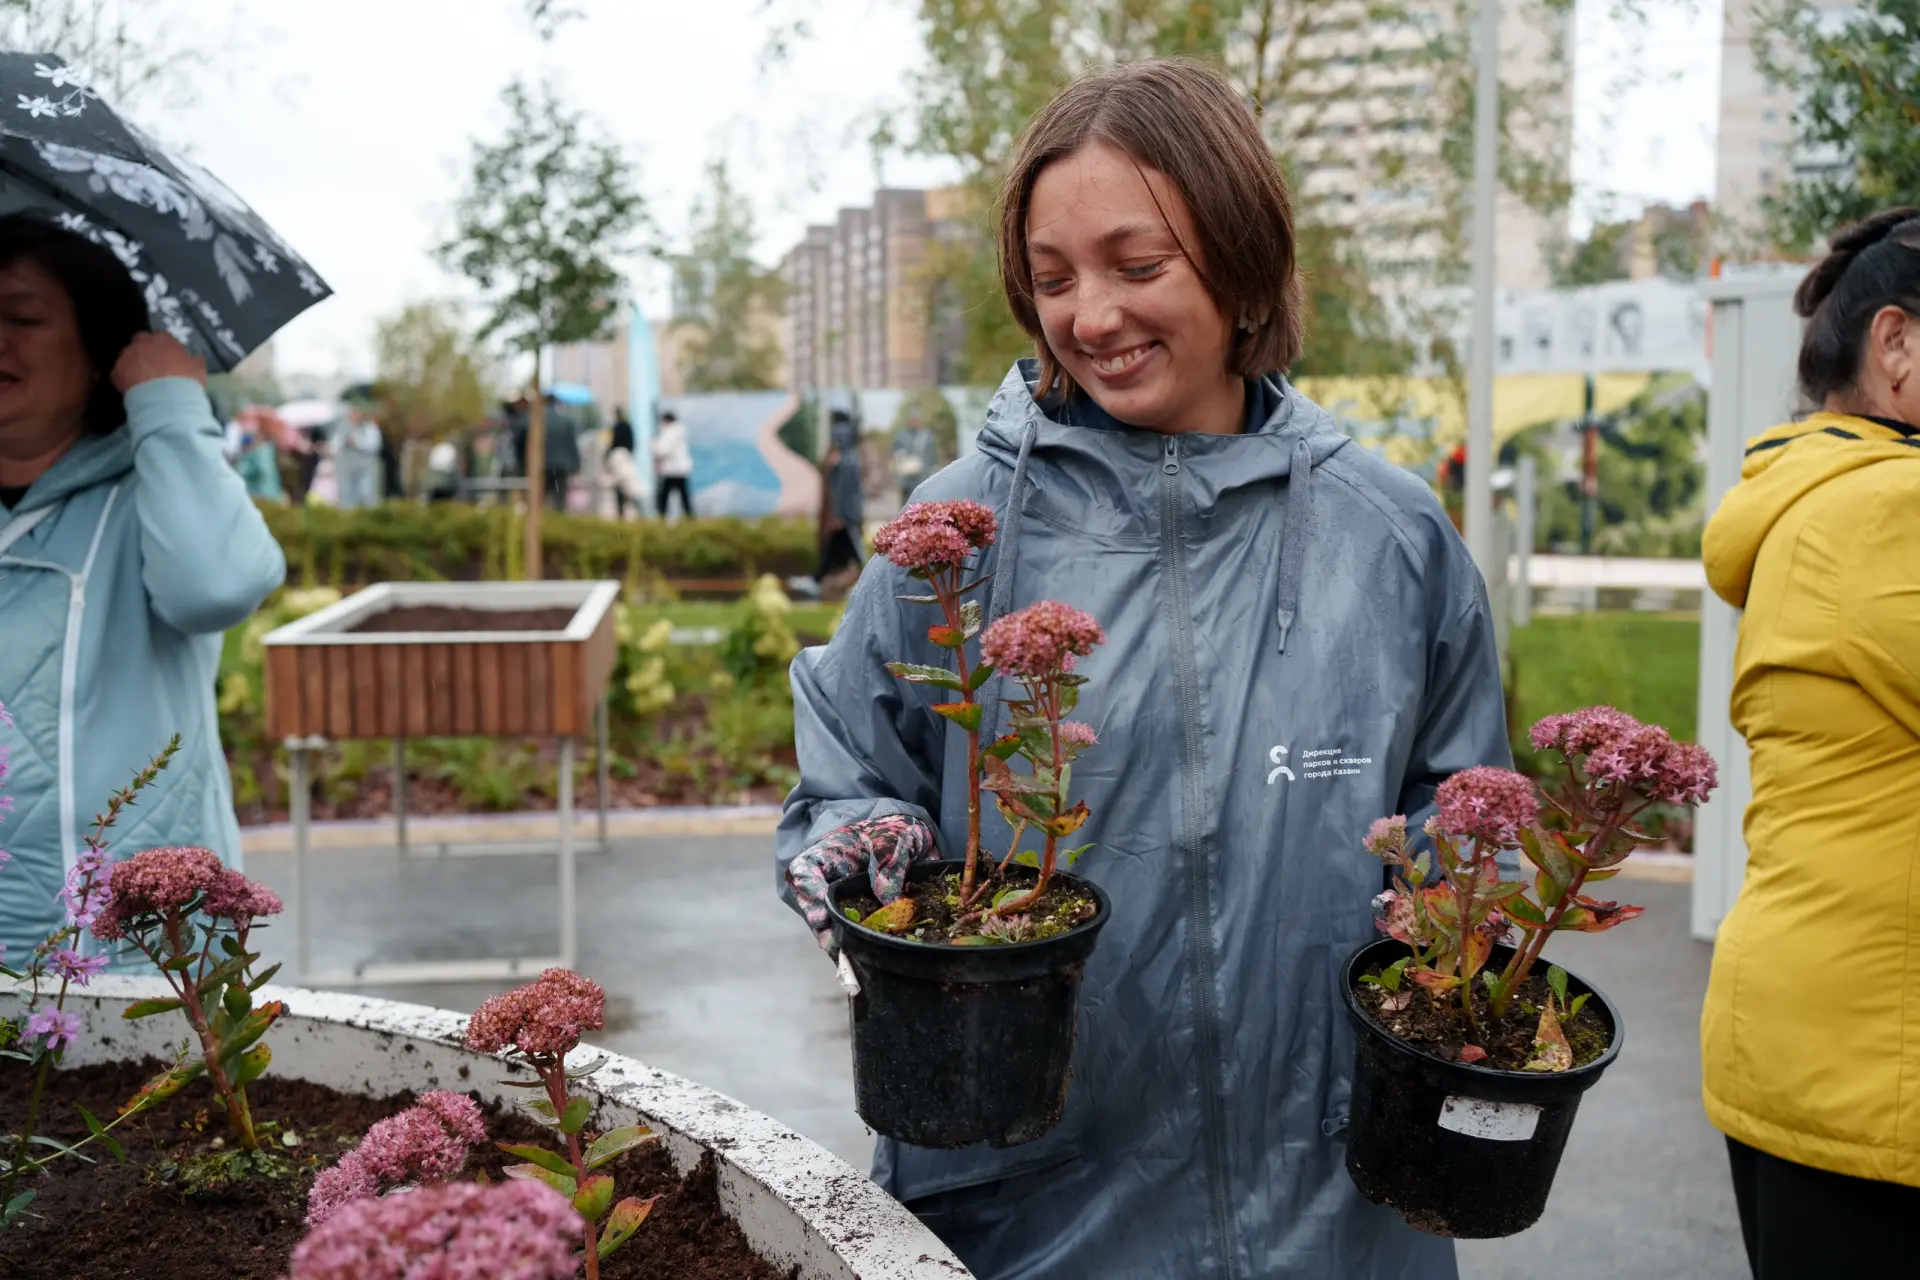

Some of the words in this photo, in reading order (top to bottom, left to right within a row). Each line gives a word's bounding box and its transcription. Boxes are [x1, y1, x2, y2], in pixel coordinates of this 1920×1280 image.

[1302, 748, 1342, 758] Дирекция
[1303, 759, 1331, 768] парков
[1339, 757, 1372, 765] скверов
[1304, 769, 1332, 779] города
